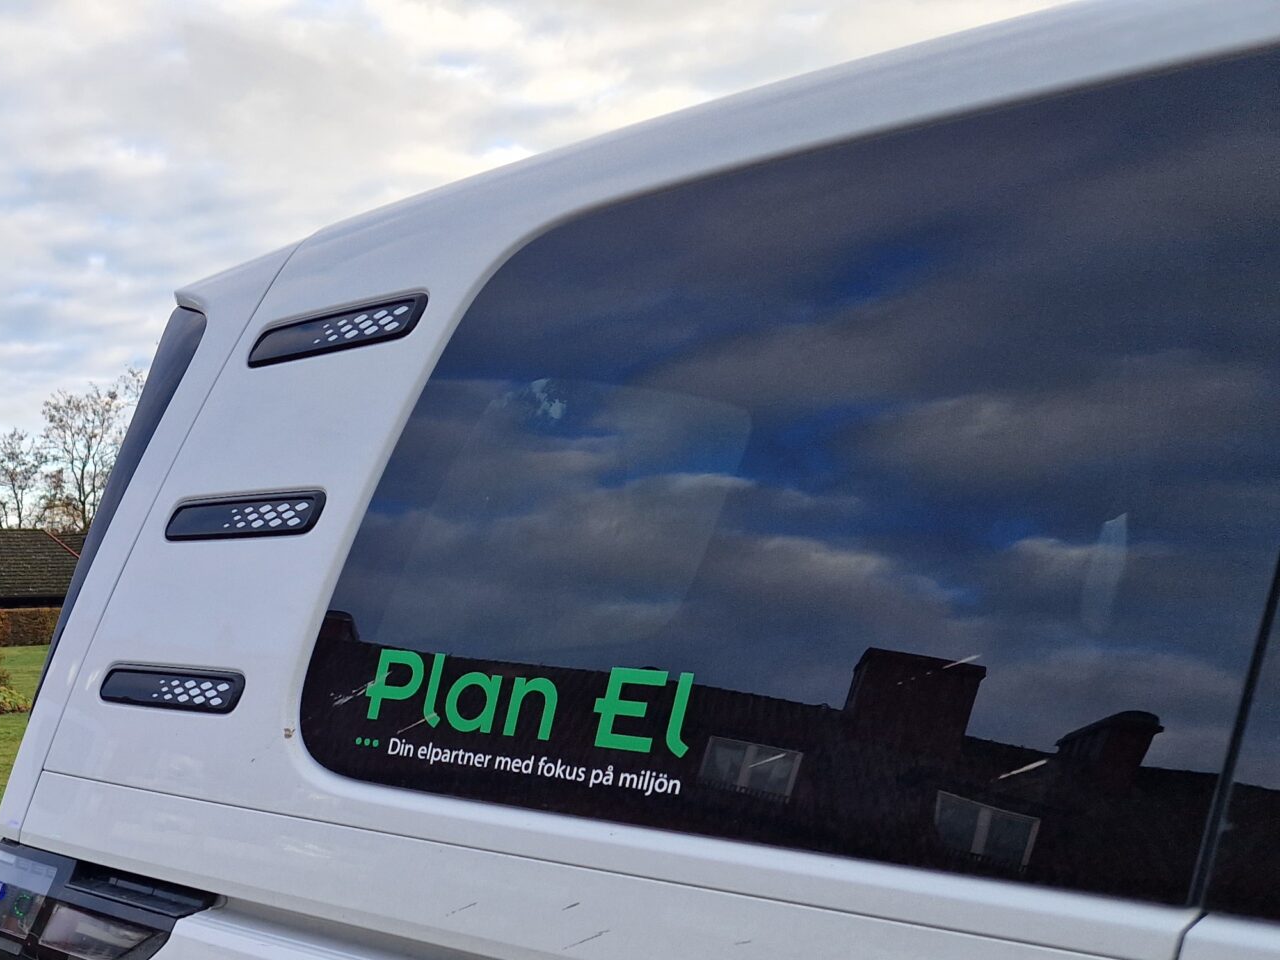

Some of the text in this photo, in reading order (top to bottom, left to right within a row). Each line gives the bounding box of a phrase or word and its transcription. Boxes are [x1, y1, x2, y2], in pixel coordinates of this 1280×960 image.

[365, 648, 695, 759] Plan El
[387, 737, 415, 759] Din
[417, 741, 493, 770] elpartner
[494, 753, 533, 776] med
[537, 756, 586, 782] fokus
[589, 763, 614, 789] på
[618, 768, 682, 797] miljön
